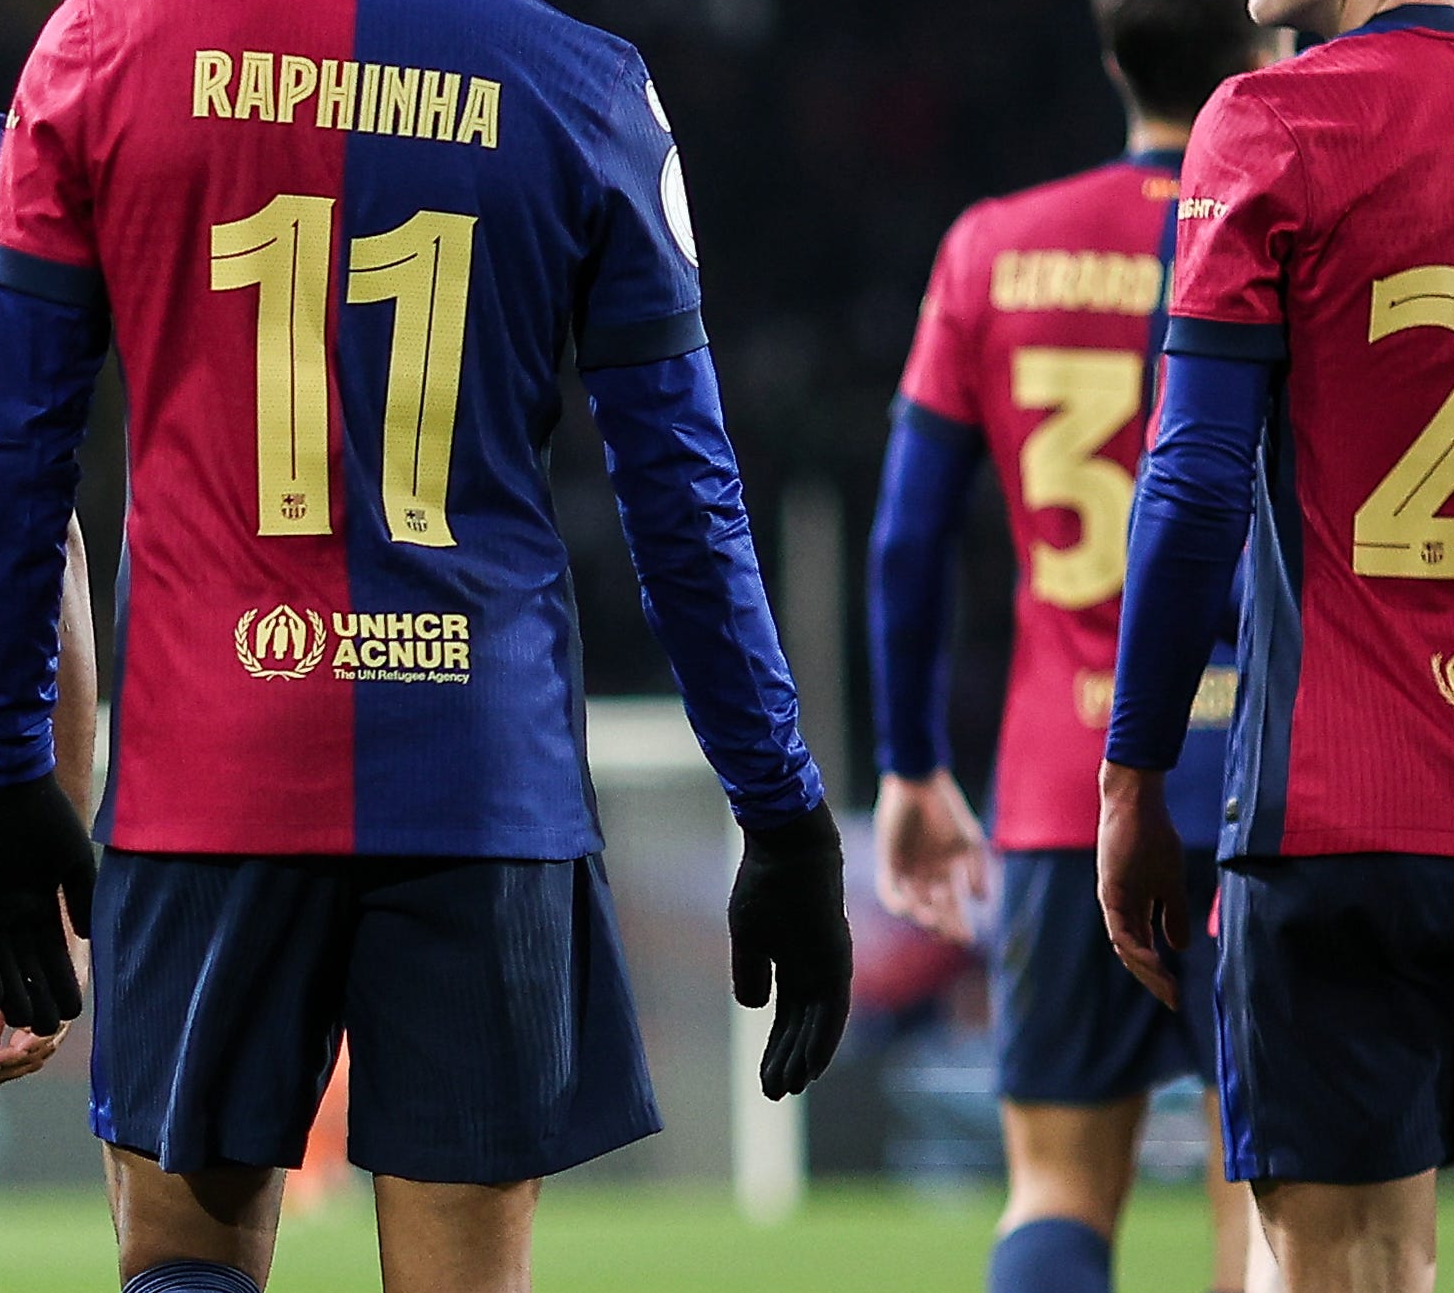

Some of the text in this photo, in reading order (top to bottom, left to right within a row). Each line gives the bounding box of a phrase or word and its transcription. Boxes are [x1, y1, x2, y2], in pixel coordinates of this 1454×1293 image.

[192, 50, 502, 149] RAPHINHA
[210, 194, 479, 547] 11
[1014, 349, 1144, 608] 3
[332, 612, 470, 639] UNHCR
[332, 639, 470, 669] ACNUR
[334, 669, 470, 684] The UN Refugee Agency
